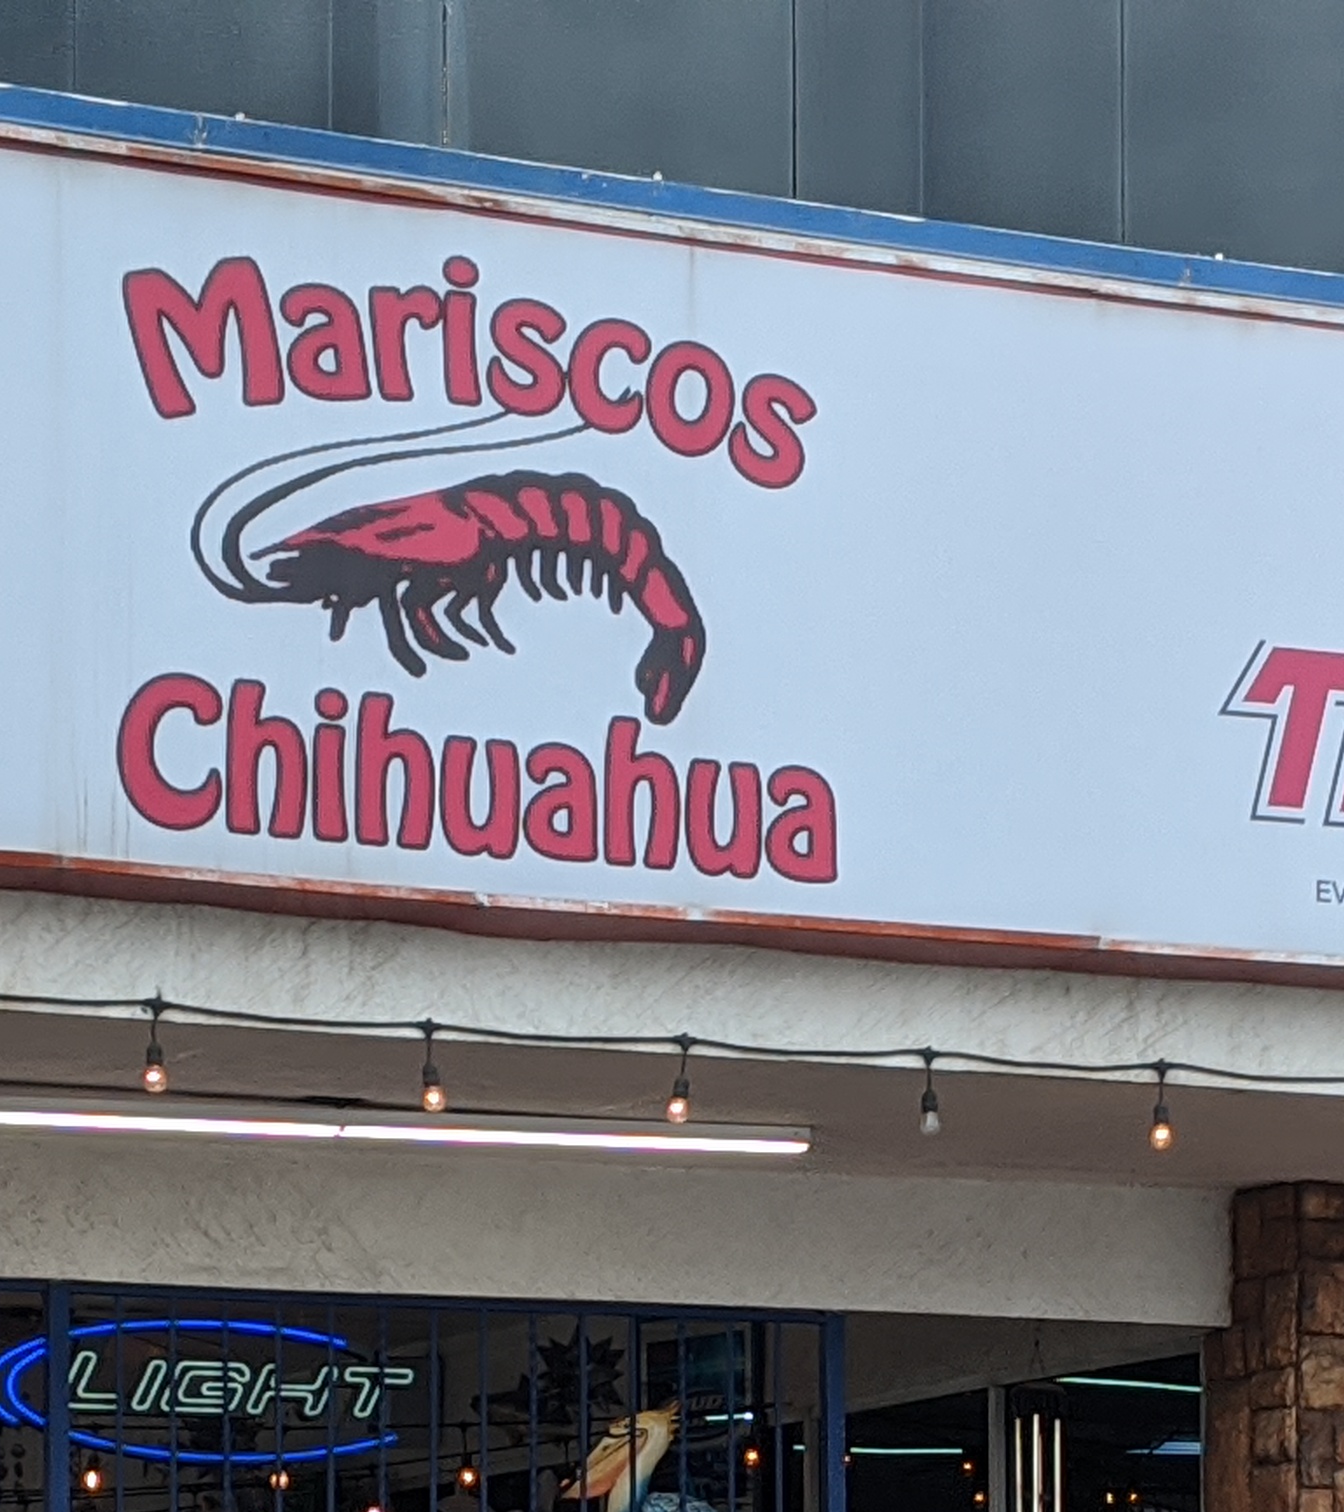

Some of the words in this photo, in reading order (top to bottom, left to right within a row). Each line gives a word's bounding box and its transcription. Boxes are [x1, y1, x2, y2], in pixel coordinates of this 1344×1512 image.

[121, 255, 817, 489] Mariscos
[117, 672, 838, 884] Chihuahua
[66, 1349, 414, 1419] LIGHT
